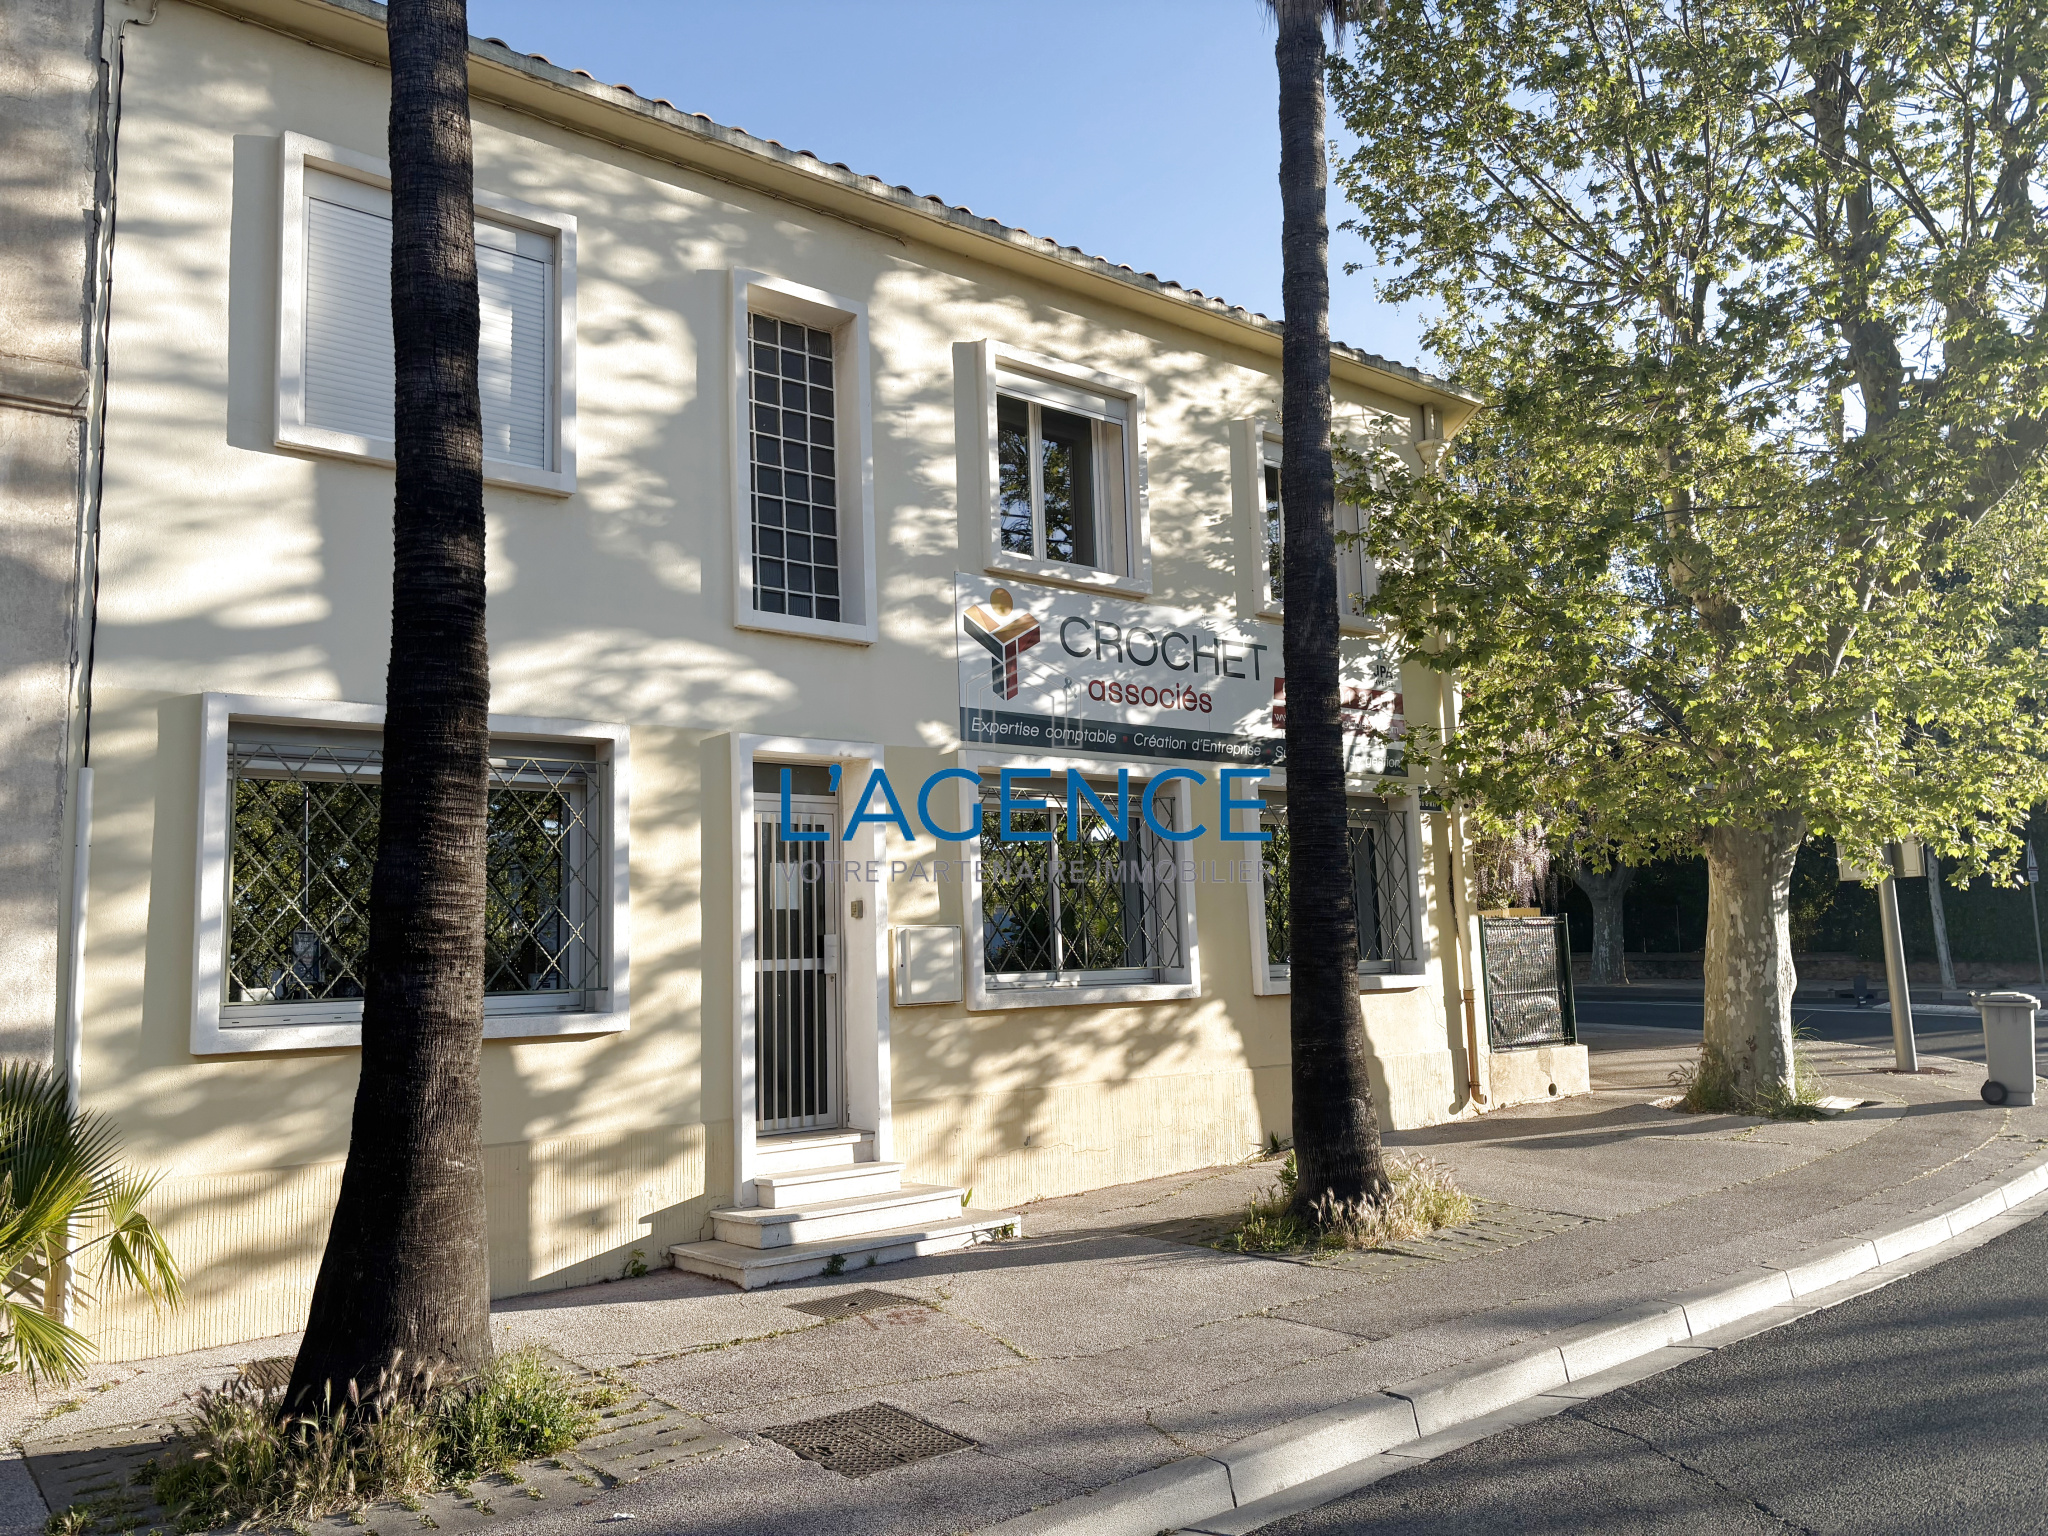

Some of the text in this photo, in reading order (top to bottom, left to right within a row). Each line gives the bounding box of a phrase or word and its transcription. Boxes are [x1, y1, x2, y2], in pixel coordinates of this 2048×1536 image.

[1059, 616, 1268, 681] CROCHET
[1088, 679, 1213, 714] associés
[971, 717, 1040, 737] Expertise
[1045, 726, 1117, 744] comptable
[1133, 732, 1187, 750] Création
[1191, 737, 1262, 757] d'Entreprise
